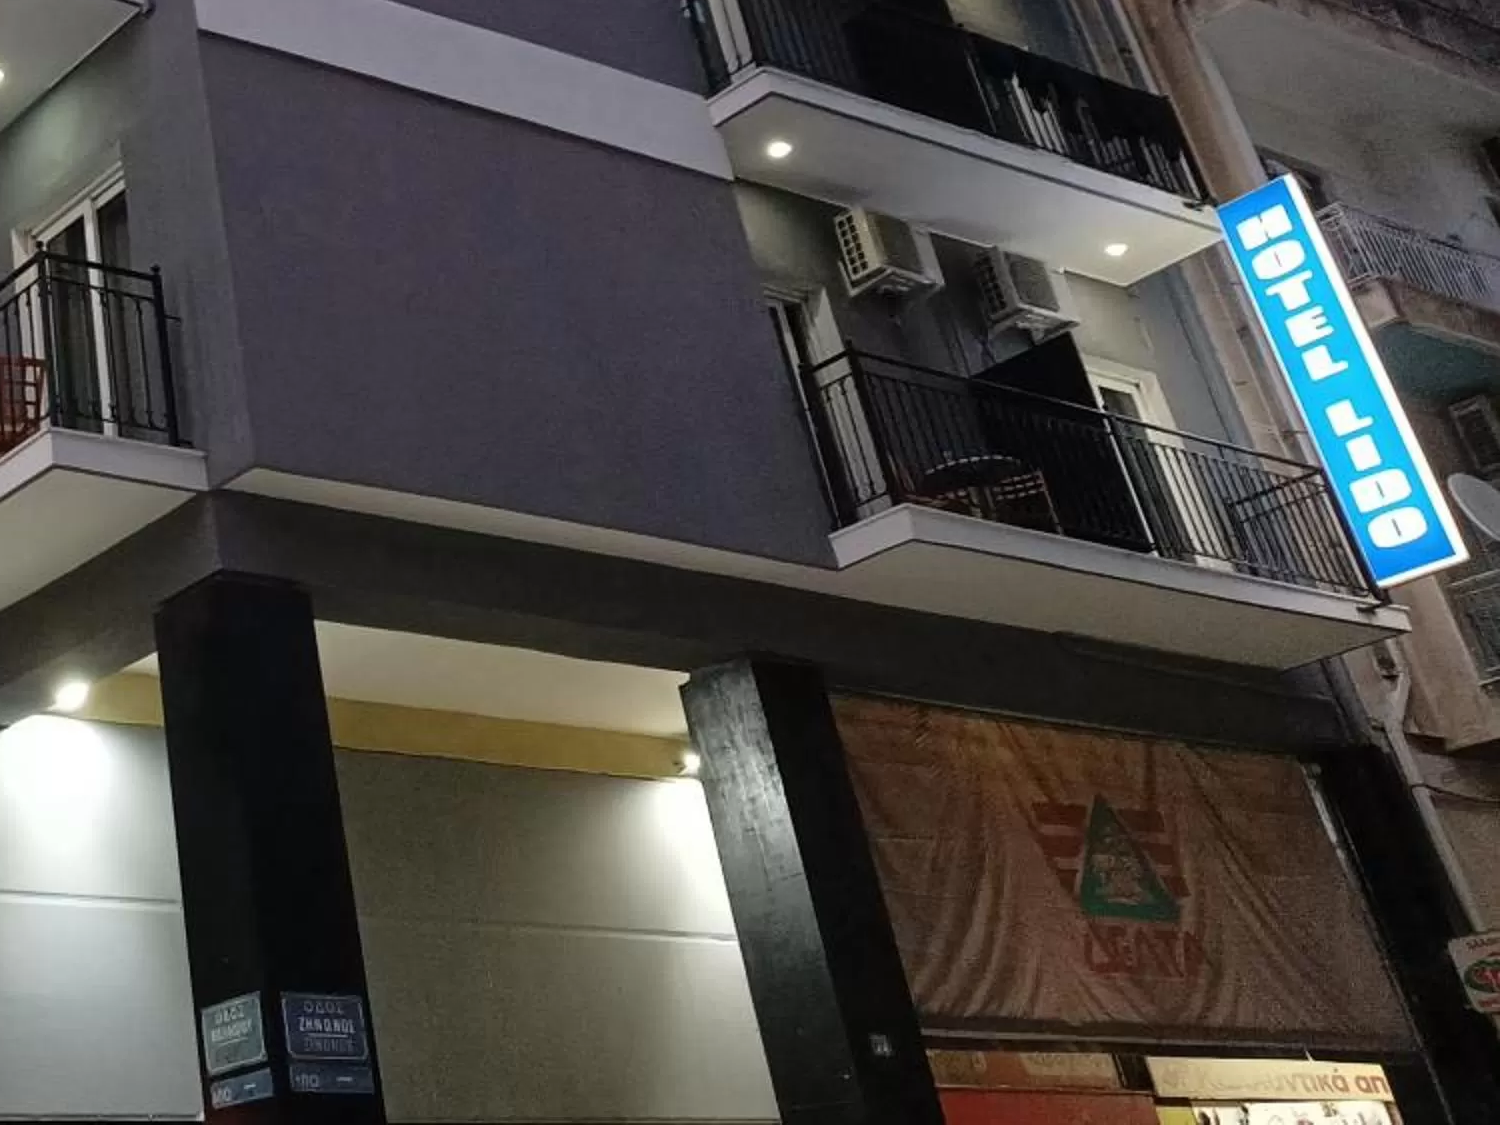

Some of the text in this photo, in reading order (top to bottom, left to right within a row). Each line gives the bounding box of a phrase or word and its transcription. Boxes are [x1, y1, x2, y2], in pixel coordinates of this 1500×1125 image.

[1236, 203, 1428, 549] HOTEL LIDO
[303, 1000, 345, 1015] ΟΔΟΣ
